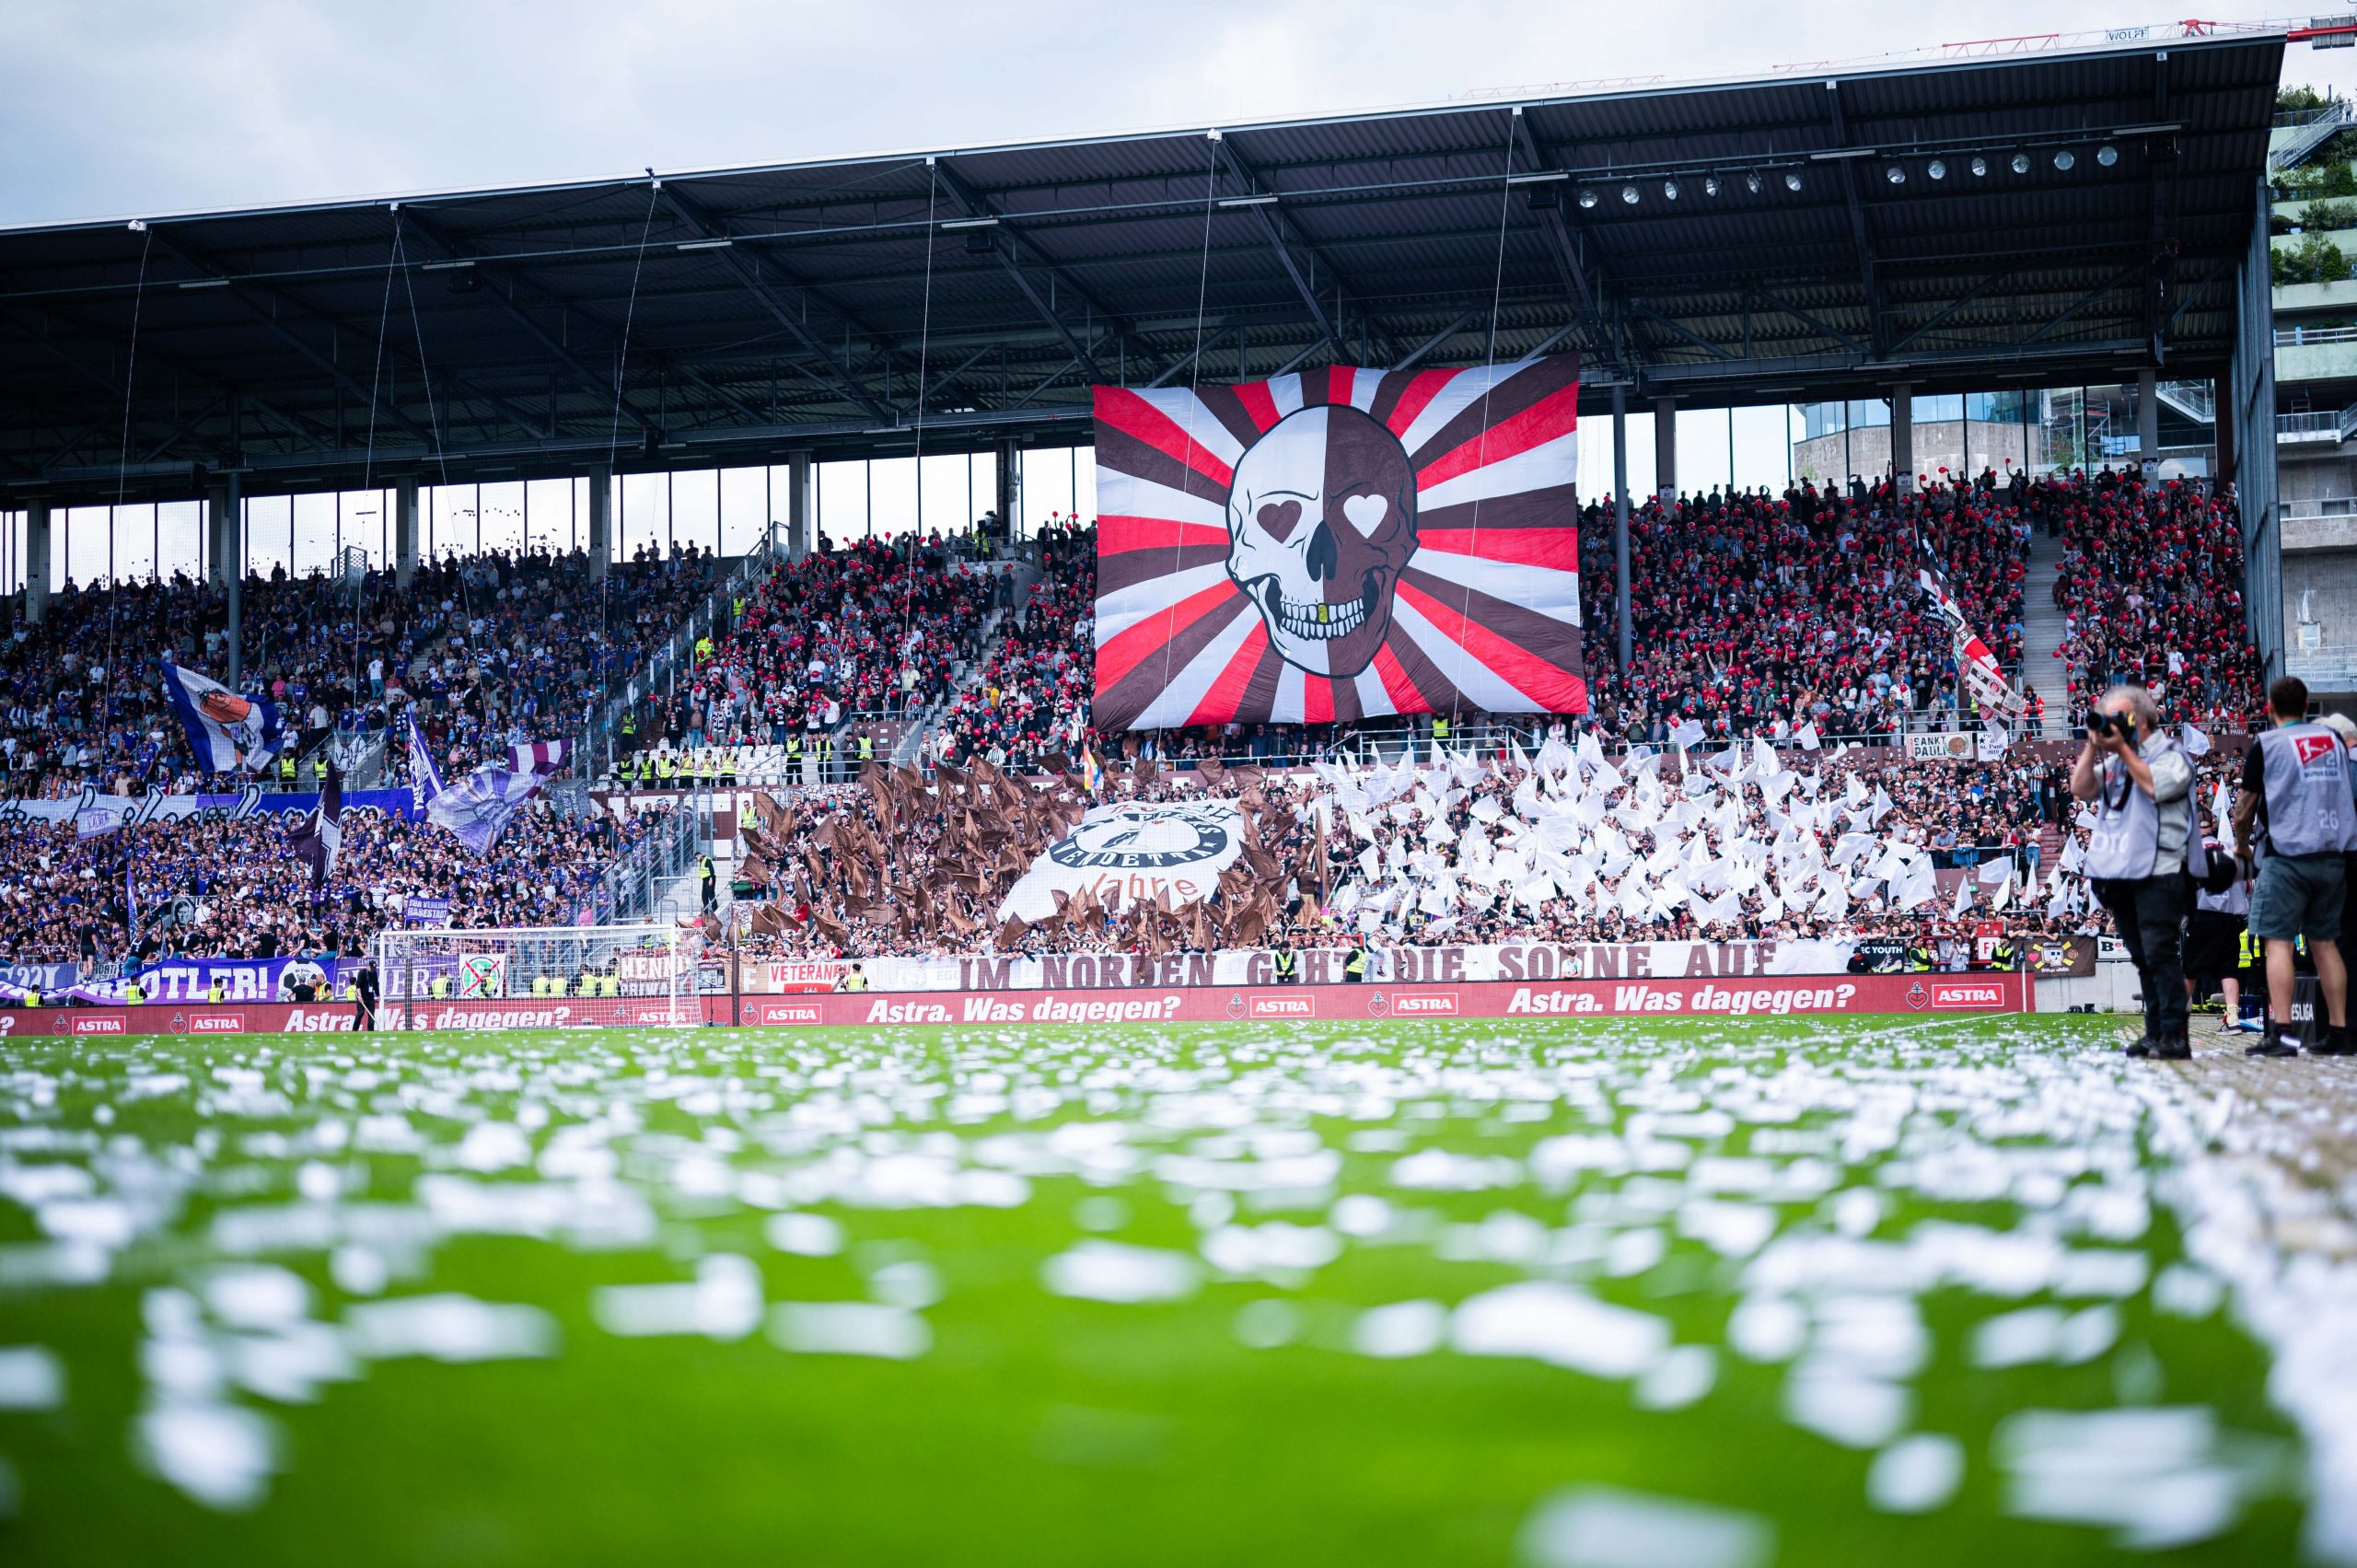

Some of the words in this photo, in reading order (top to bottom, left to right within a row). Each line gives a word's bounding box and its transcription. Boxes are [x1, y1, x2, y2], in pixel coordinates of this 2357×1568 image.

[2108, 25, 2148, 41] WOLFF
[1913, 736, 1946, 746] SANKT
[1914, 745, 1946, 757] PAULI
[2318, 810, 2339, 830] 26
[1052, 842, 1213, 868] VENDETTA
[1872, 946, 1903, 955] YOUTH
[958, 958, 1013, 990] IM
[1041, 954, 1217, 989] NORDEN
[1392, 948, 1467, 982] DIE
[1684, 942, 1777, 977] AUF
[1507, 988, 1604, 1013] Astra.
[1614, 985, 1683, 1012] Was
[1691, 983, 1856, 1016] dagegen?
[1938, 989, 1998, 1002] ASTRA
[866, 999, 953, 1023] Astra.
[963, 997, 1025, 1022] Was
[1032, 995, 1181, 1023] dagegen?
[1255, 1001, 1309, 1013] ASTRA
[1398, 998, 1453, 1010] ASTRA
[284, 1009, 363, 1032] Astra.
[435, 1006, 571, 1029] dagegen?
[766, 1009, 817, 1020] ASTRA
[76, 1021, 121, 1031] ASTRA
[194, 1019, 239, 1029] ASTRA
